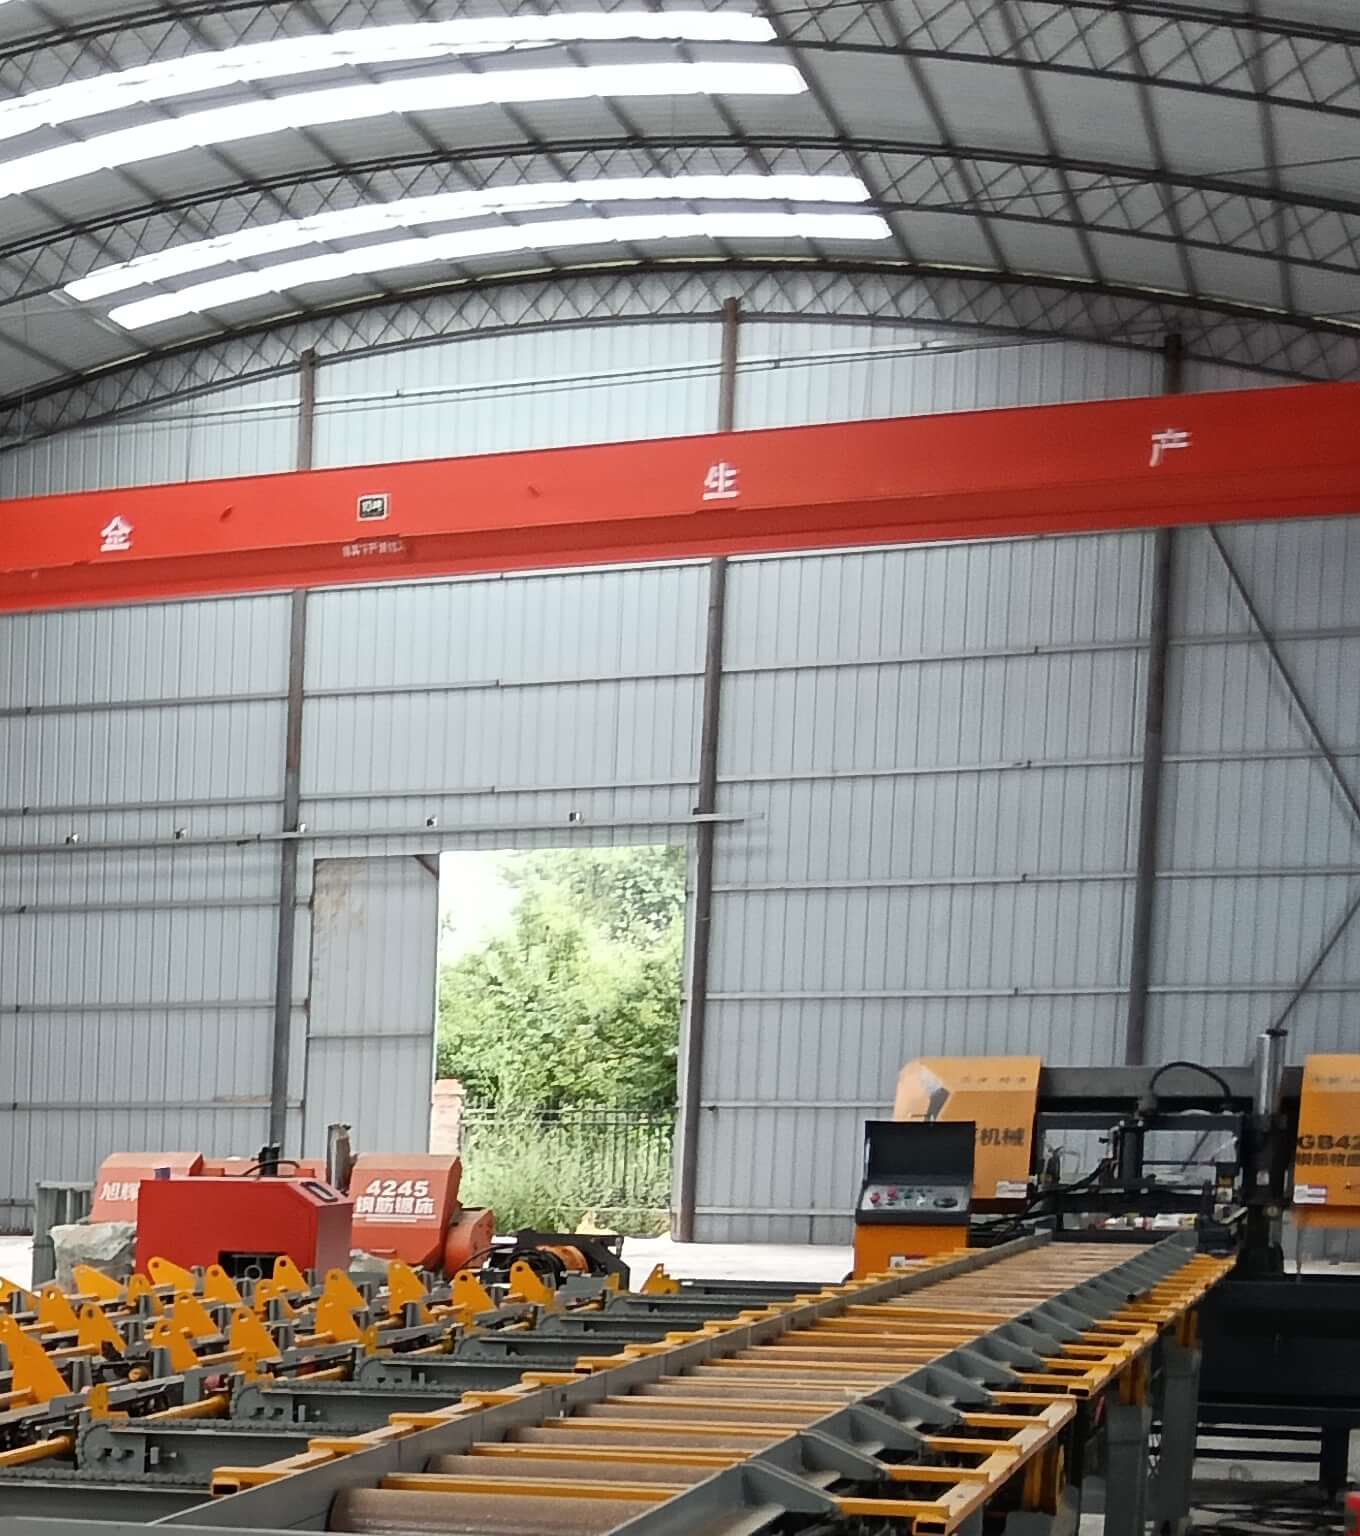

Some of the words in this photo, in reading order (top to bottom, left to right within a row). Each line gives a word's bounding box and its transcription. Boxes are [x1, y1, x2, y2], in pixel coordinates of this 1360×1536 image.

[100, 514, 133, 553] 全
[702, 461, 741, 501] 生
[1150, 427, 1192, 467] 产
[366, 1179, 429, 1197] 4245
